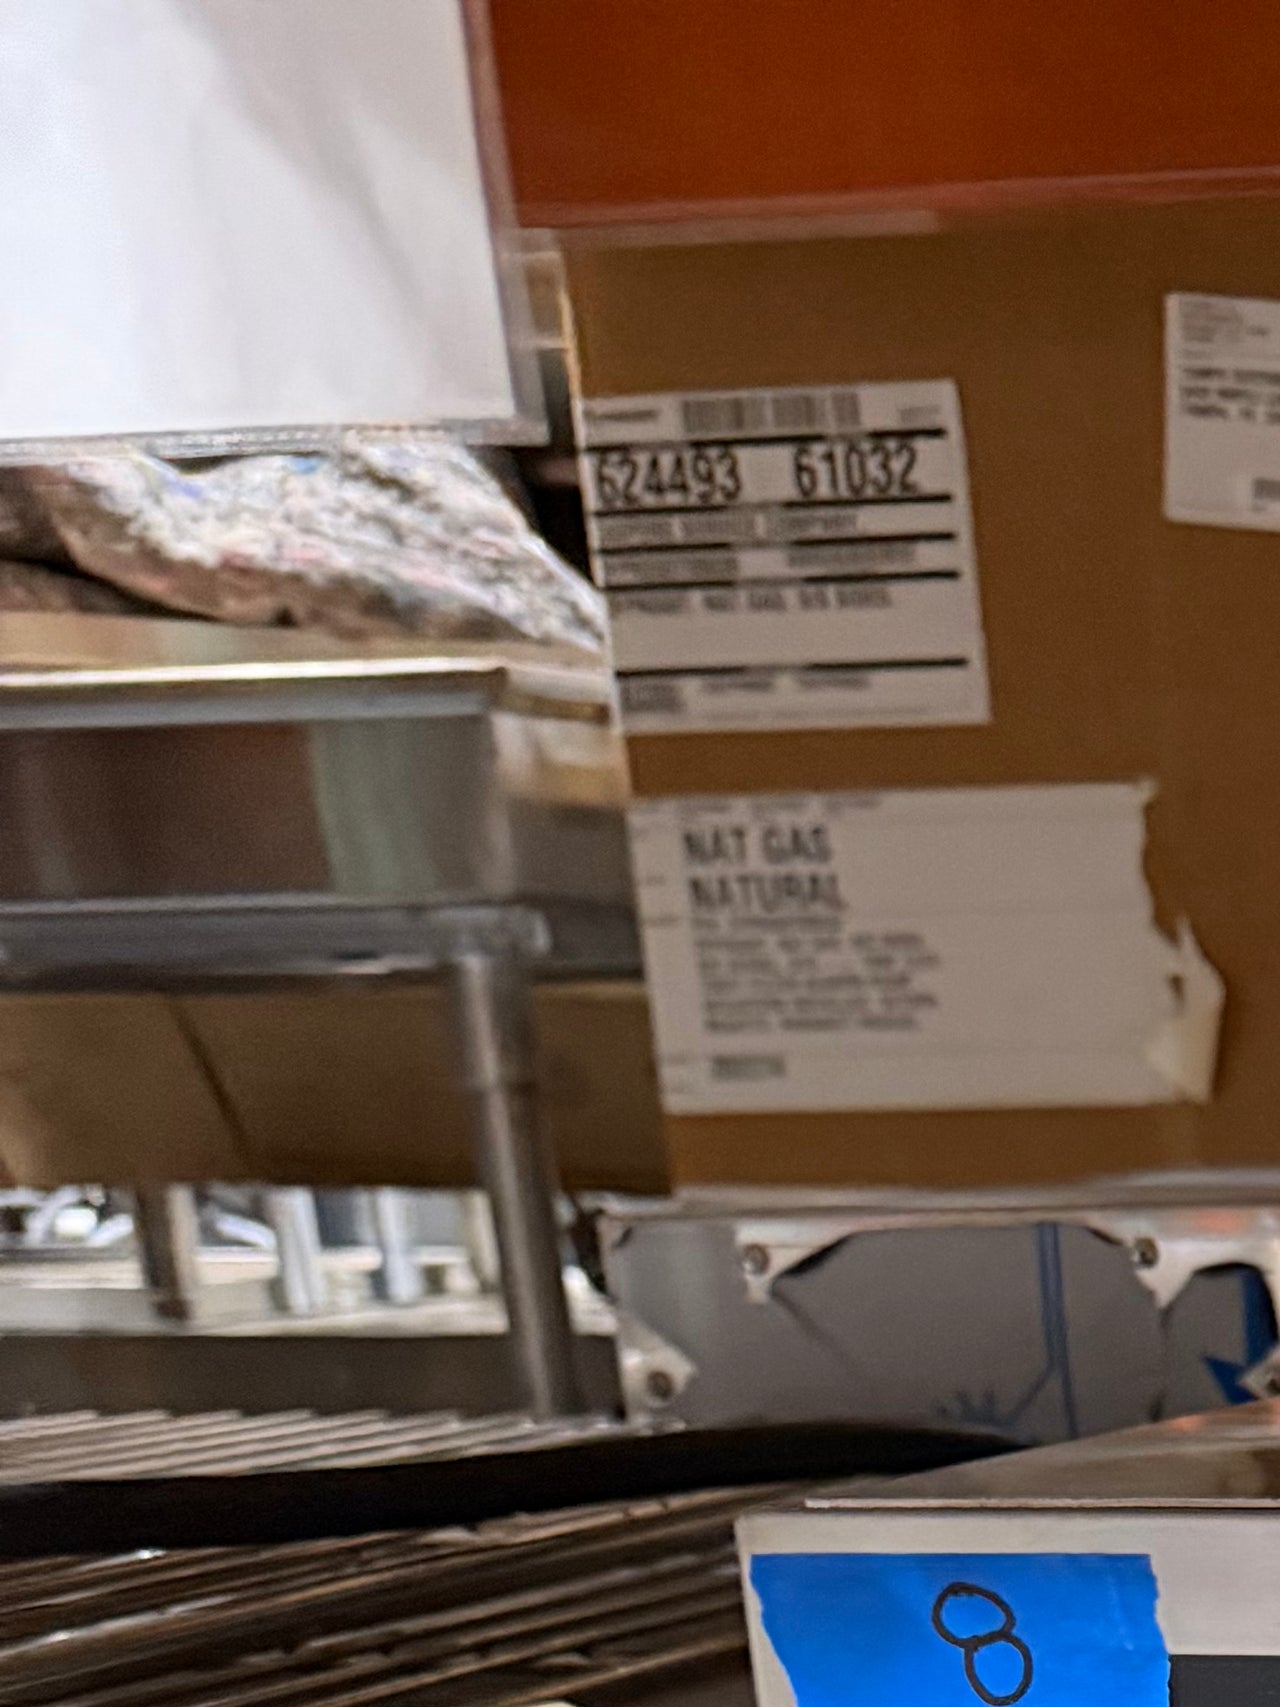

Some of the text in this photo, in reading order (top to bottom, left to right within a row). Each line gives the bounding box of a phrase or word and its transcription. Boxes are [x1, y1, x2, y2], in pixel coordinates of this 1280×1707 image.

[792, 443, 919, 497] 61032
[682, 823, 834, 865] NAT GAS
[688, 874, 849, 914] NATURAL
[931, 1581, 1033, 1707] 8
